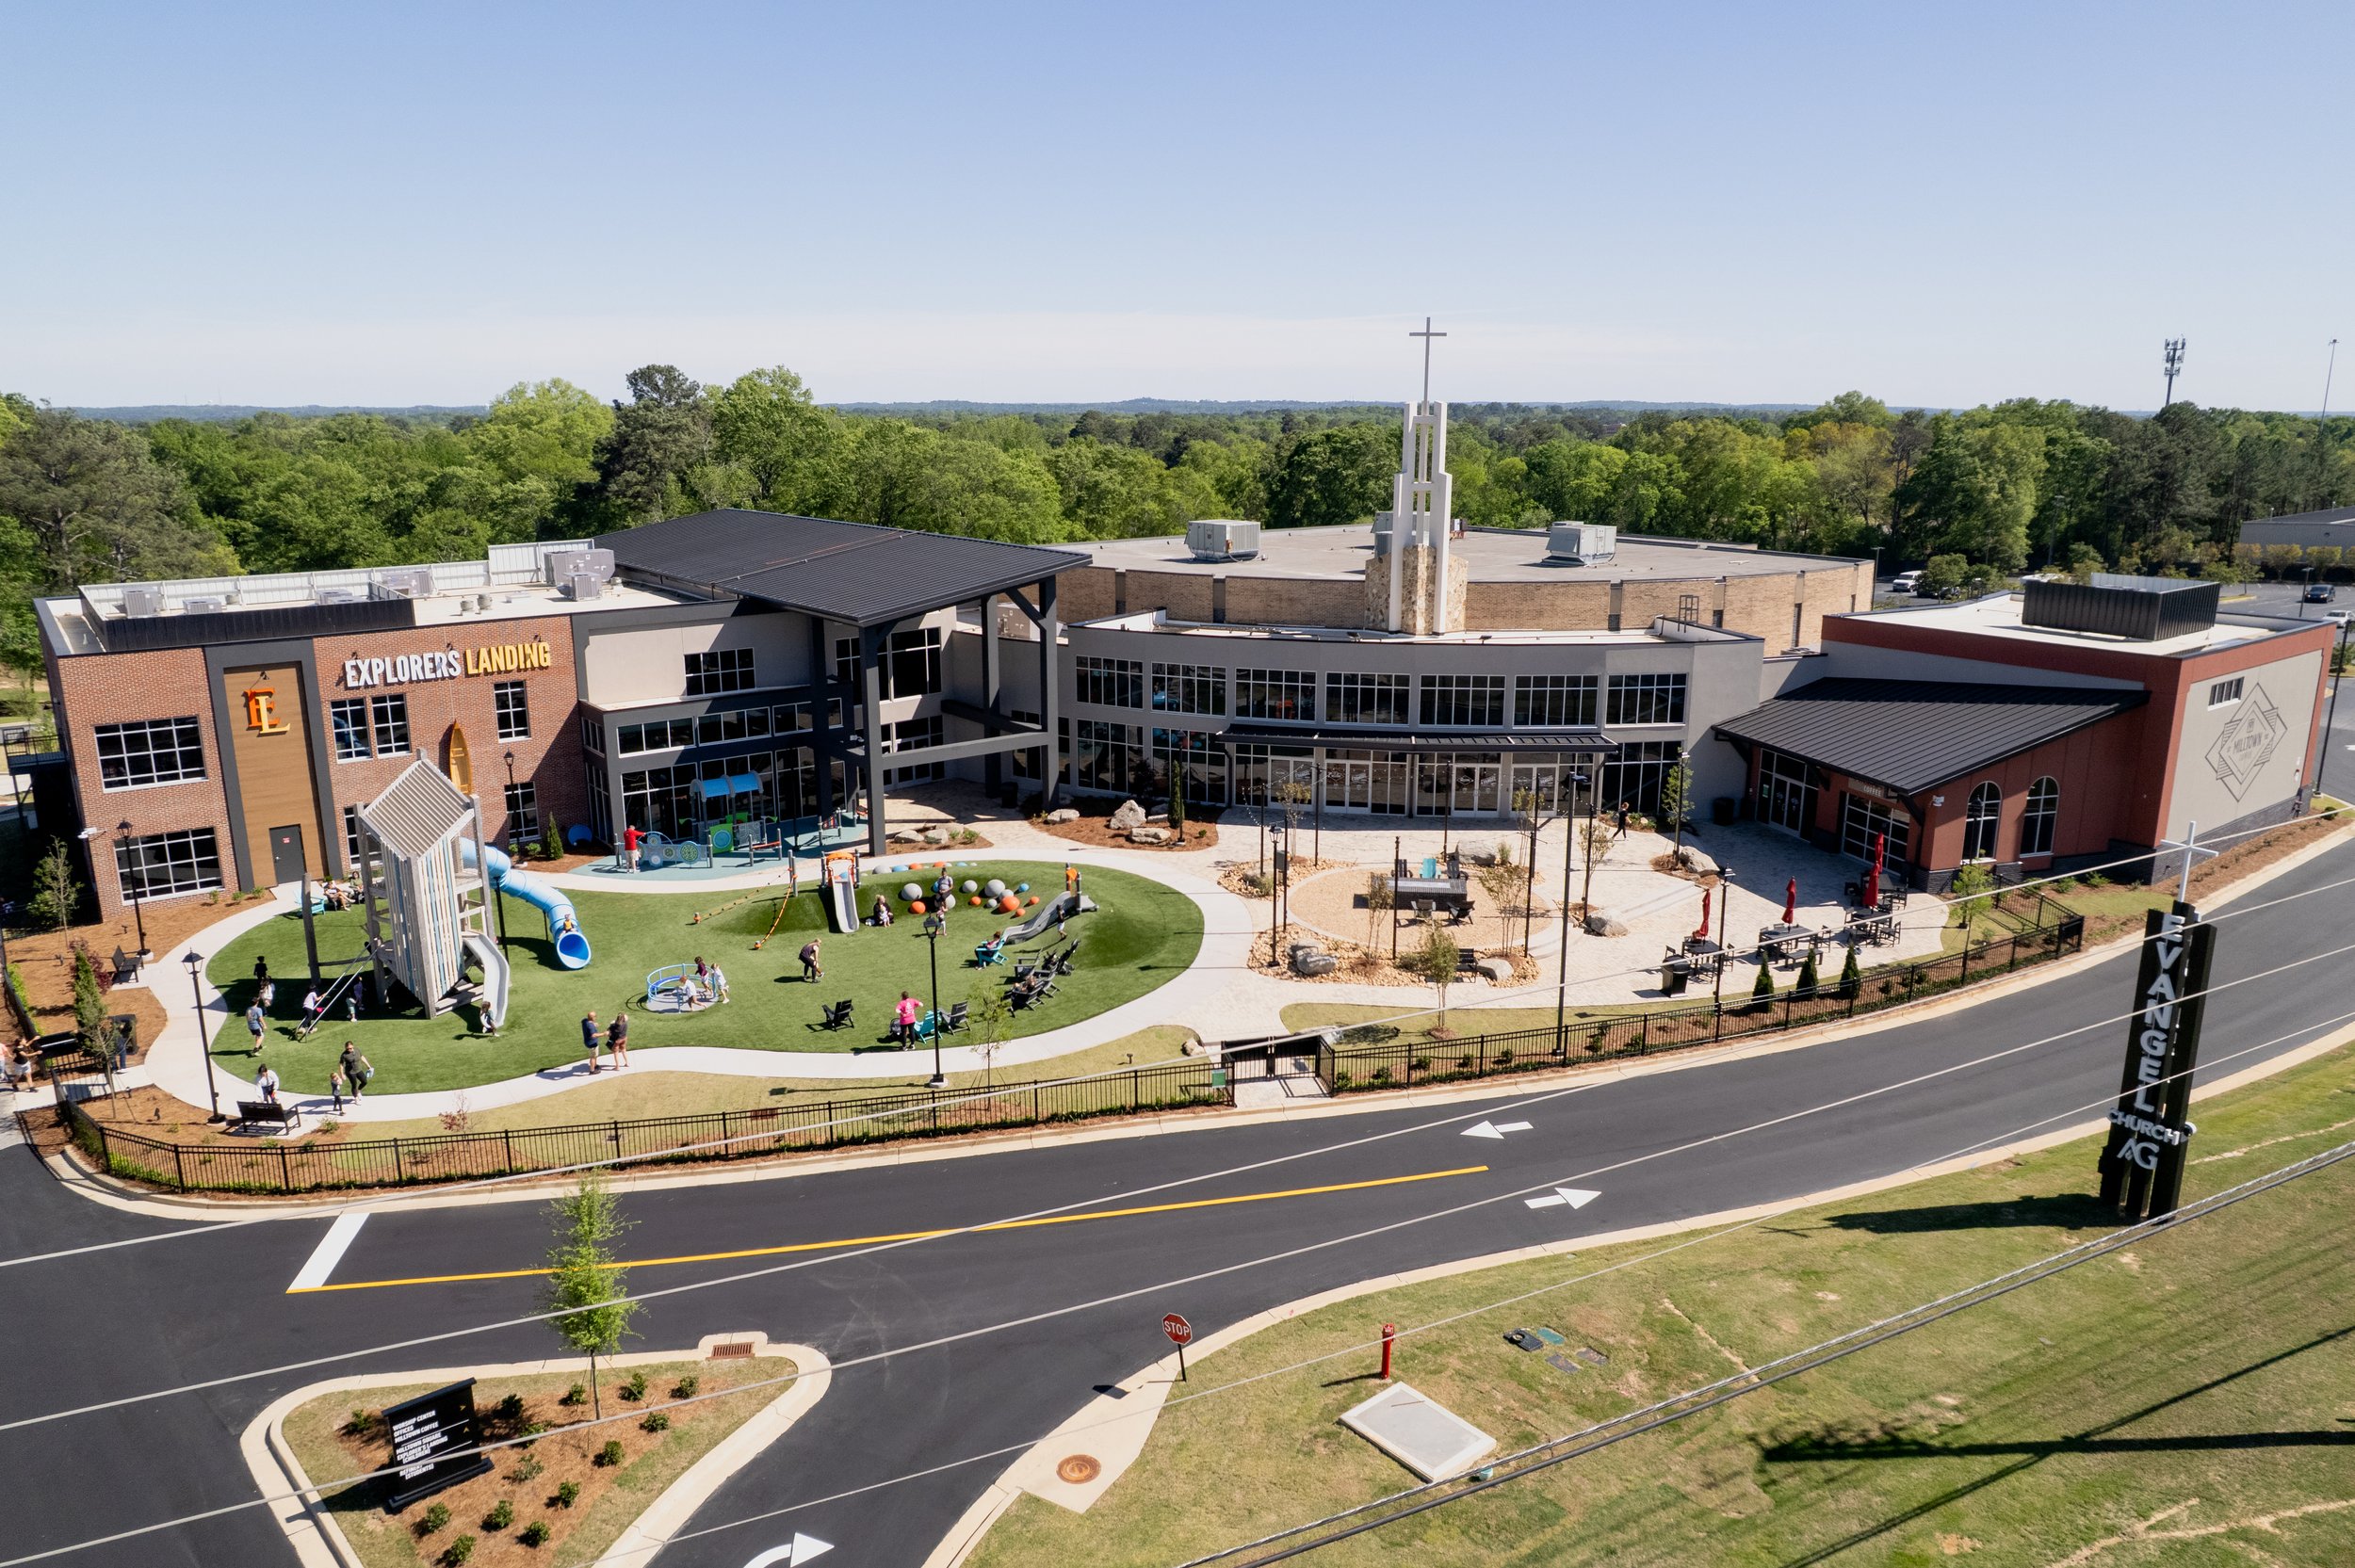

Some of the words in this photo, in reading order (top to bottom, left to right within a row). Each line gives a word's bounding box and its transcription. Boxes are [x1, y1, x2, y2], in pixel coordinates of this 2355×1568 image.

[345, 650, 462, 687] EXPLORERS
[465, 642, 550, 674] LANDING
[2233, 733, 2263, 754] MILLTOWN
[2134, 912, 2185, 1113] EVANGEL
[2108, 1107, 2181, 1146] CHURCH
[1164, 1320, 1189, 1336] STOP
[392, 1417, 416, 1431] WORSHIP
[416, 1410, 435, 1421] CENTER
[394, 1425, 414, 1437] OFFICES
[395, 1429, 420, 1444] MILLTOWN
[421, 1421, 439, 1433] COFFEE
[396, 1440, 422, 1455] MILLTOWN
[422, 1431, 442, 1444] SQUARE
[427, 1435, 448, 1448] LANDING
